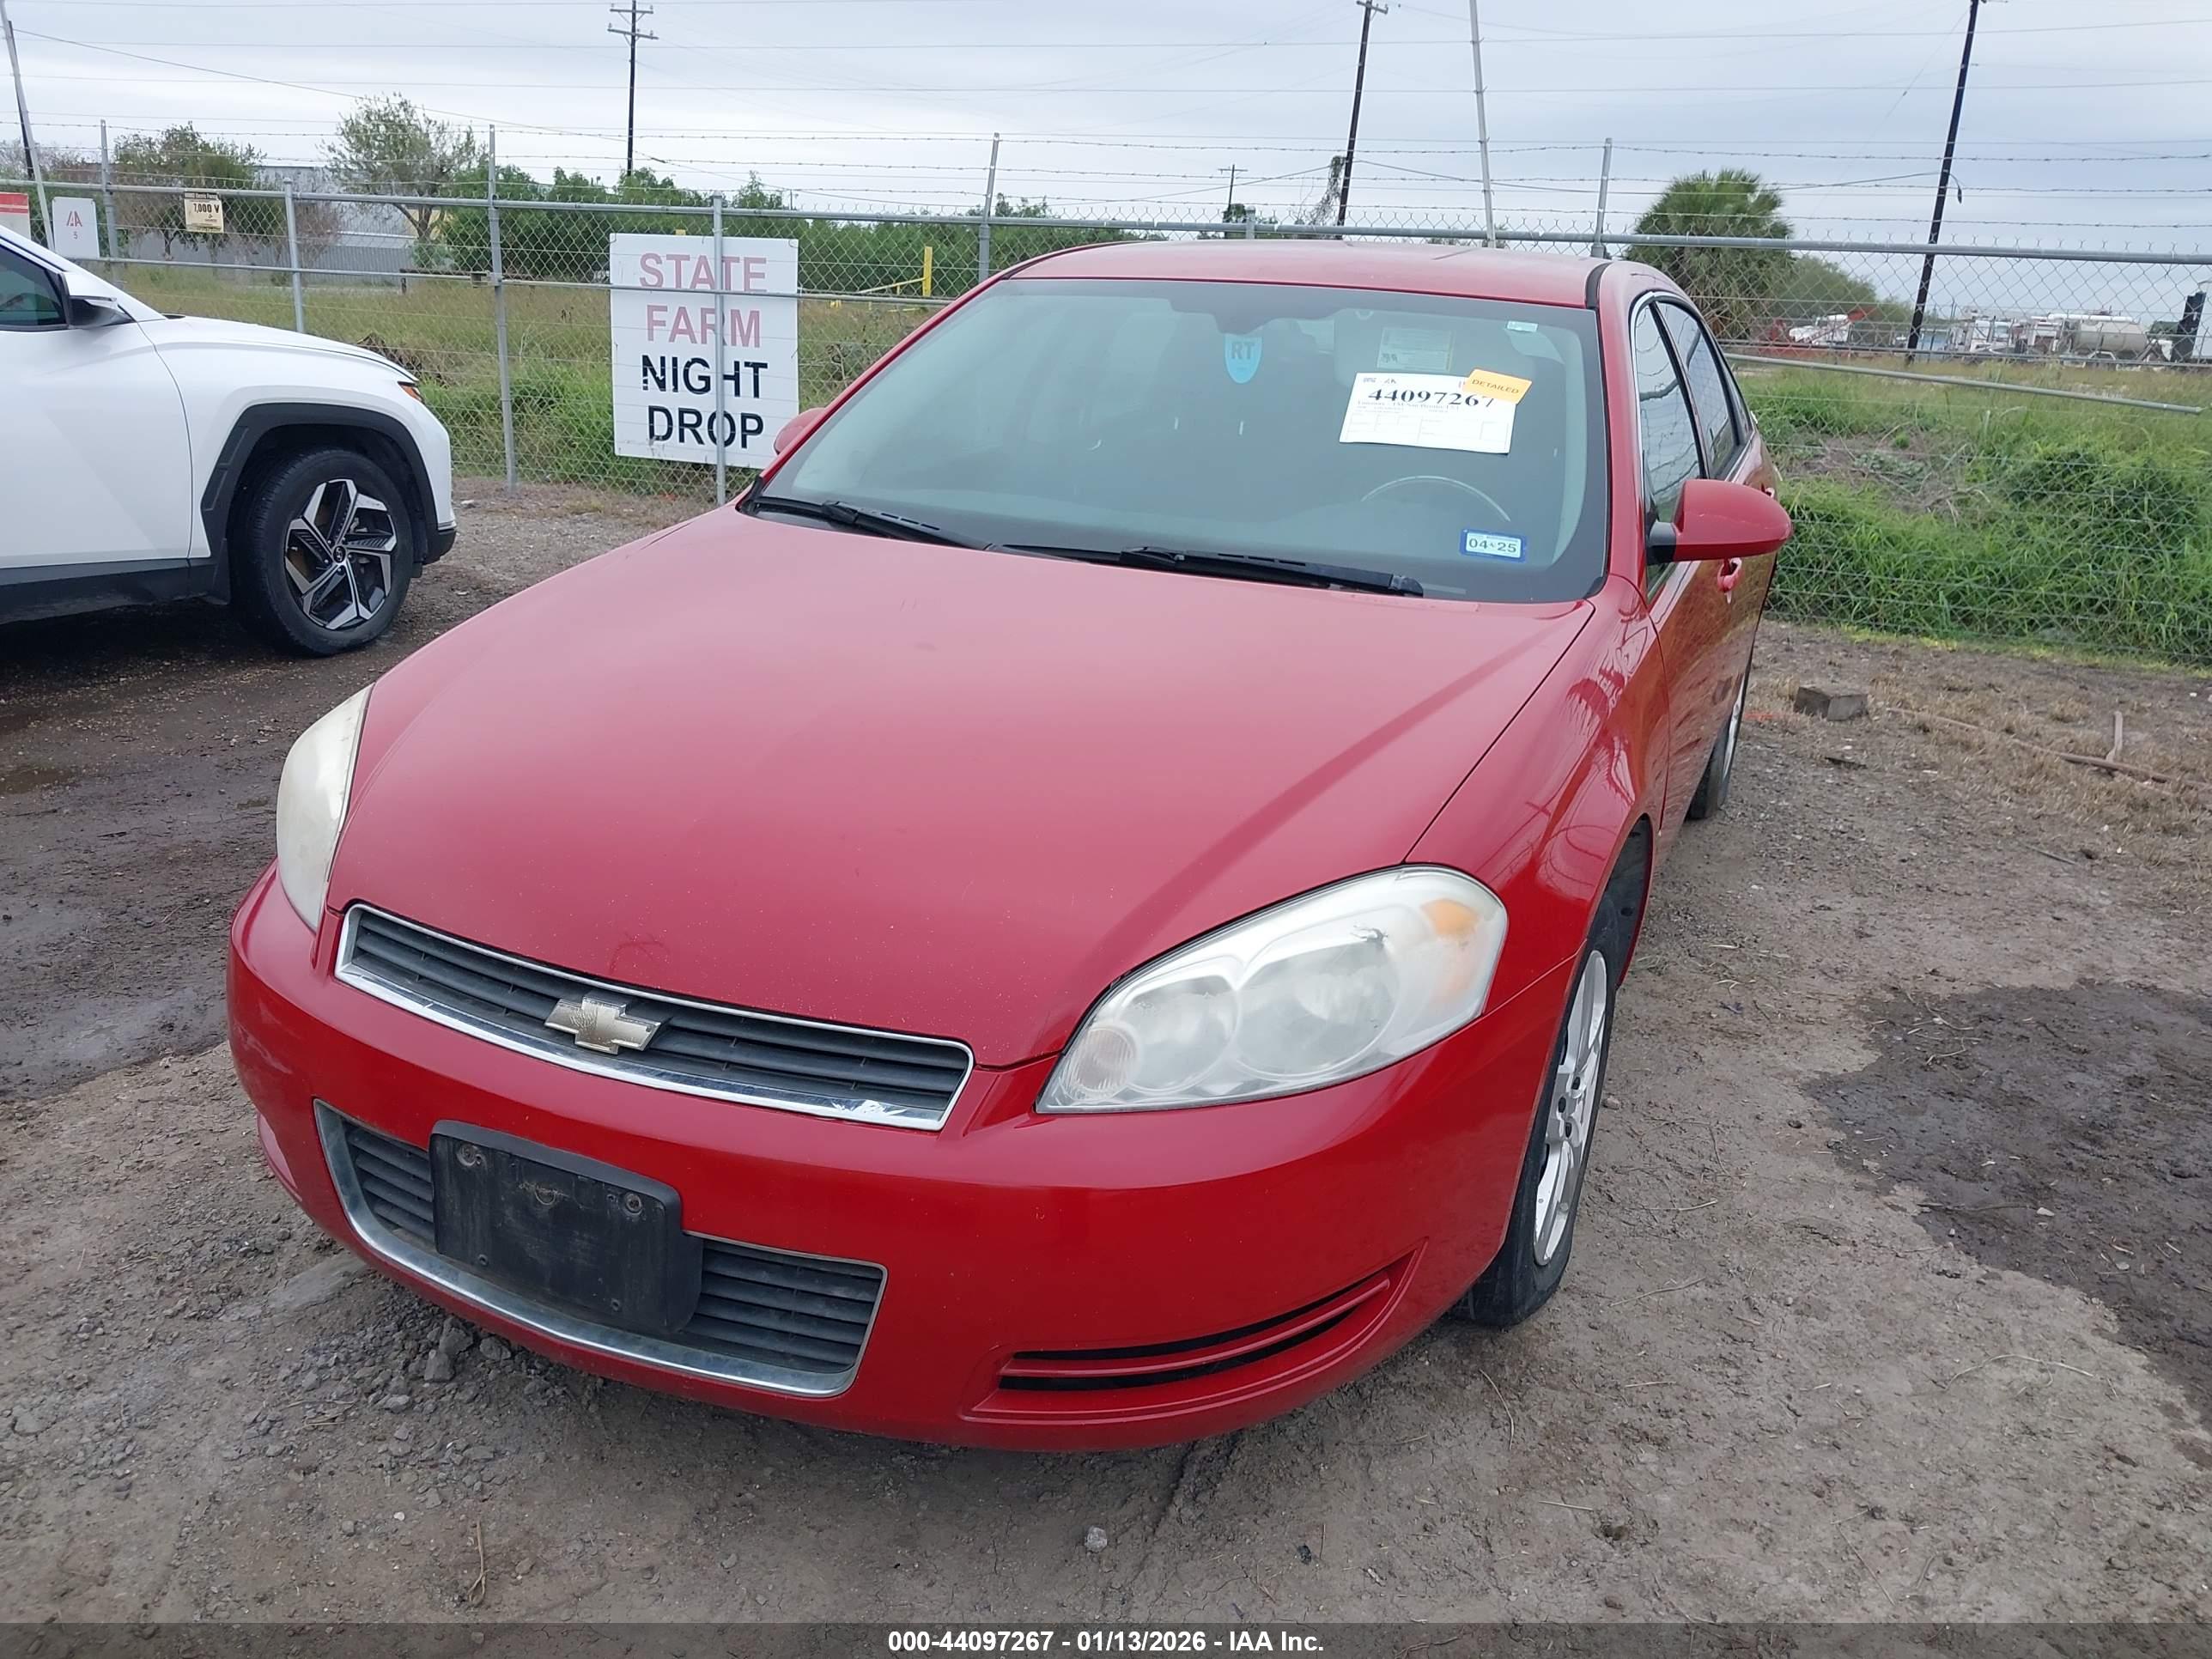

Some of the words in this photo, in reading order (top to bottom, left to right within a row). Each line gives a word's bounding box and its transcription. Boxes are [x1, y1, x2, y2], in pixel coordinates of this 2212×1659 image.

[192, 203, 212, 214] 7,000
[214, 204, 220, 214] V
[639, 252, 768, 293] STATE
[646, 305, 761, 349] FARM
[1231, 342, 1256, 361] RT
[641, 355, 769, 399] NIGHT
[1471, 379, 1520, 395] DETAILED
[1368, 388, 1494, 408] 44097267
[647, 405, 764, 449] DROP
